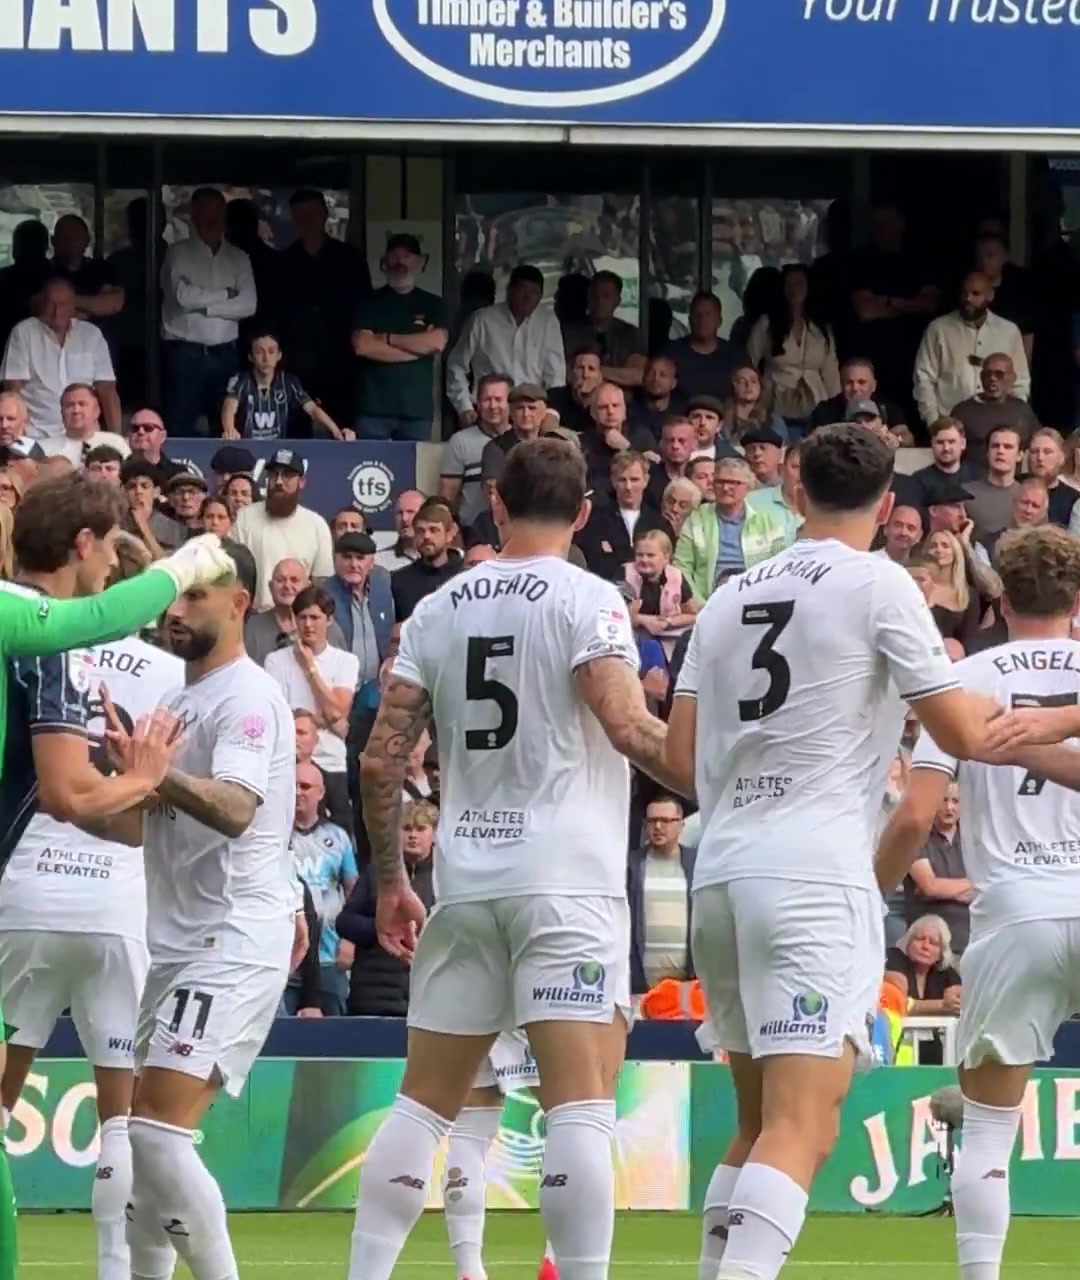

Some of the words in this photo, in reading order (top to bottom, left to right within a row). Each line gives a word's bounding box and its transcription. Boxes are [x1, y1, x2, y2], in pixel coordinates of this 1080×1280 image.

[470, 32, 631, 69] Merchants
[358, 477, 386, 496] tfs
[92, 649, 152, 678] ROE
[738, 599, 796, 722] 3
[992, 650, 1080, 676] ENGEL
[465, 635, 519, 750] 5
[454, 826, 522, 839] ELEVATED
[40, 847, 113, 867] ATHLETES
[37, 862, 110, 880] ELEVATED
[532, 987, 604, 1004] Williams
[169, 988, 214, 1040] 11
[760, 1019, 827, 1036] Williams
[495, 1064, 537, 1079] Willia
